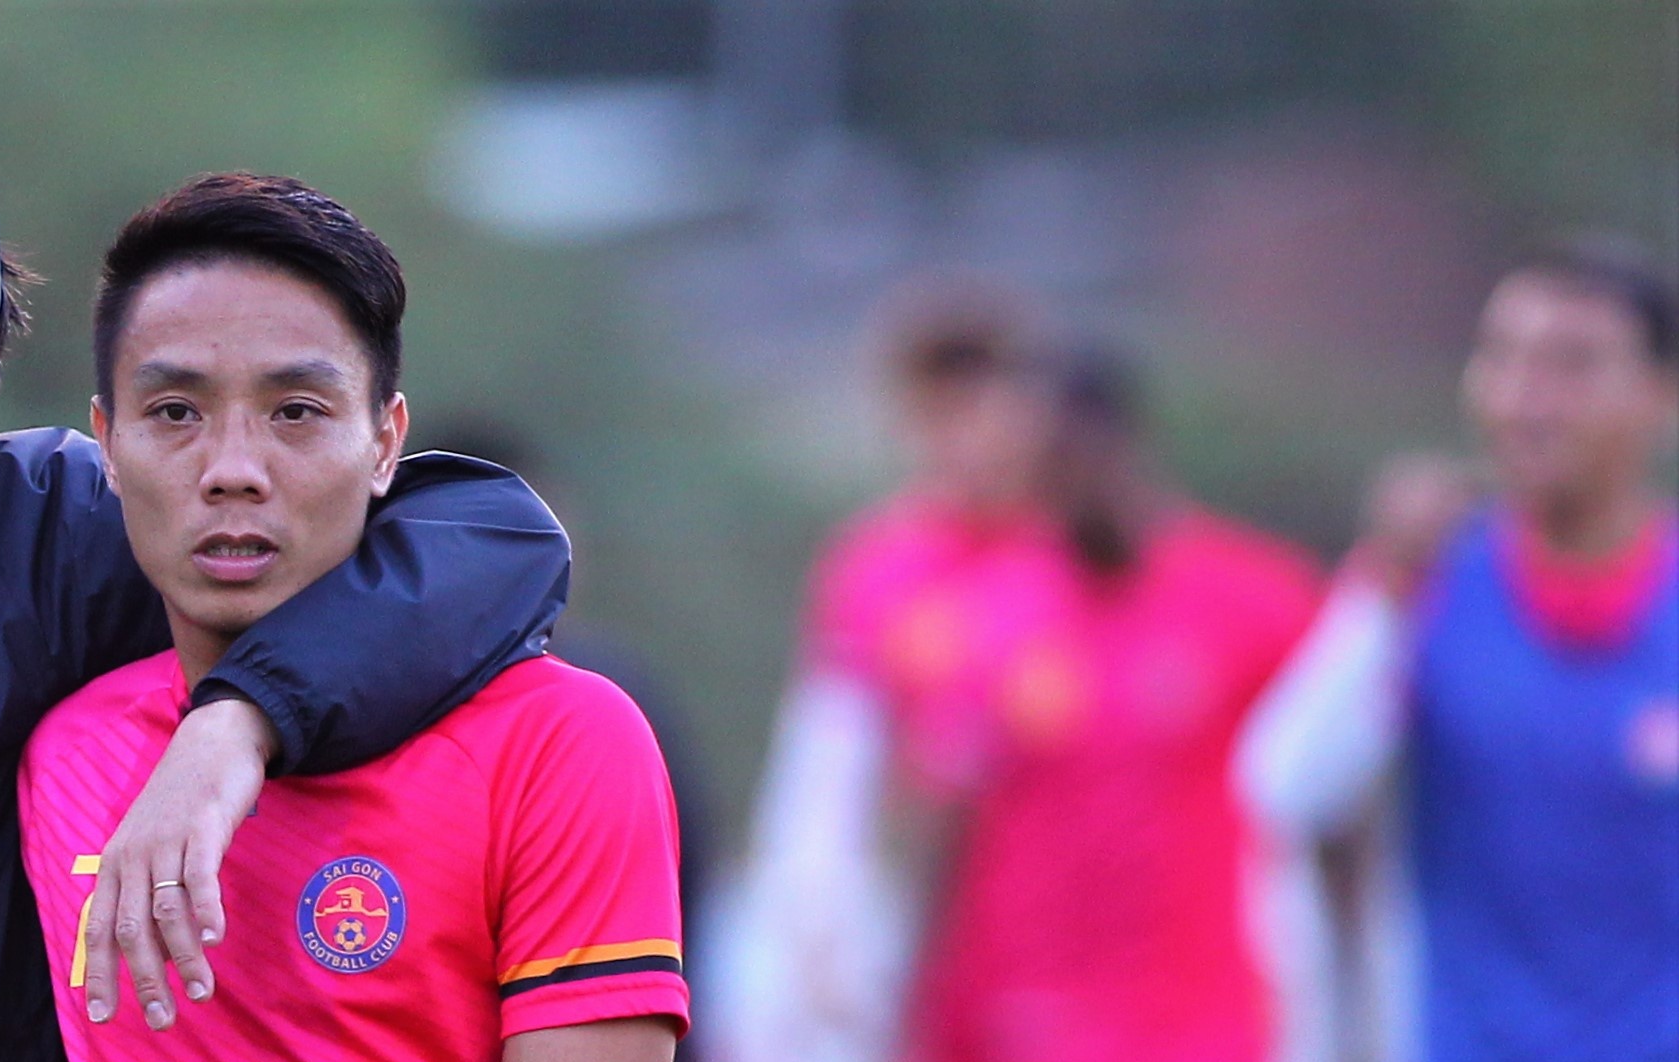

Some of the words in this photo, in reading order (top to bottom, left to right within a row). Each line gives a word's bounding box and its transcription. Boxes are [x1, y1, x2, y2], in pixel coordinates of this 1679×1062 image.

[323, 863, 347, 882] SAI
[351, 861, 383, 881] GON
[303, 931, 368, 969] FOOTBALL
[370, 930, 399, 961] CLUB
